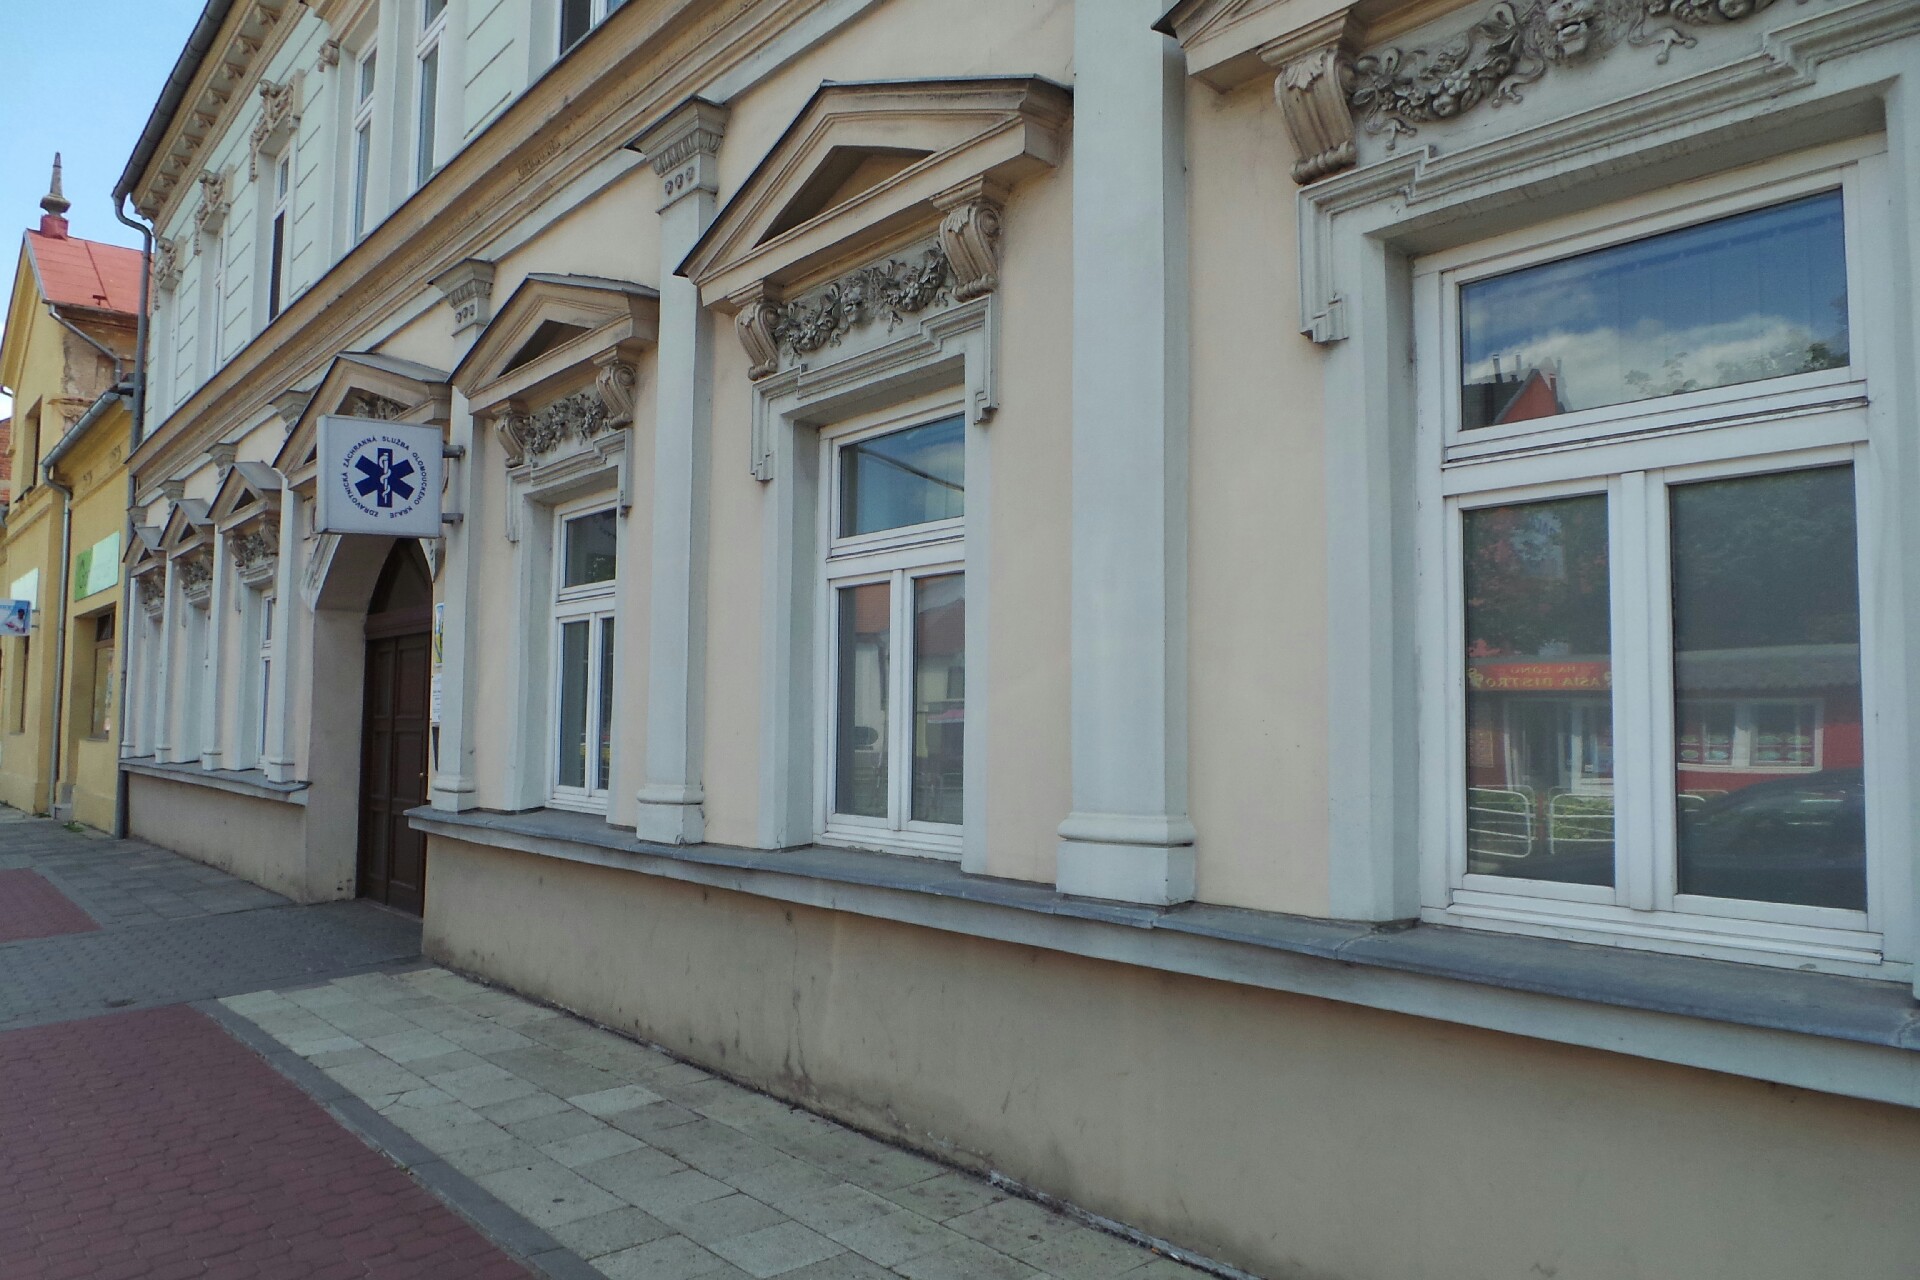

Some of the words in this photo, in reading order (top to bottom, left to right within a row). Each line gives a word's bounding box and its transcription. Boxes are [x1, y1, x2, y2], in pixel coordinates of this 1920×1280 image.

[342, 435, 377, 468] ZÁCHRANNÁ
[382, 435, 410, 451] SLUŽBA
[341, 472, 379, 518] ZDRAVOTNICKÁ
[412, 452, 428, 505] OLOMOUCKÉHO
[390, 505, 413, 519] KRAJE
